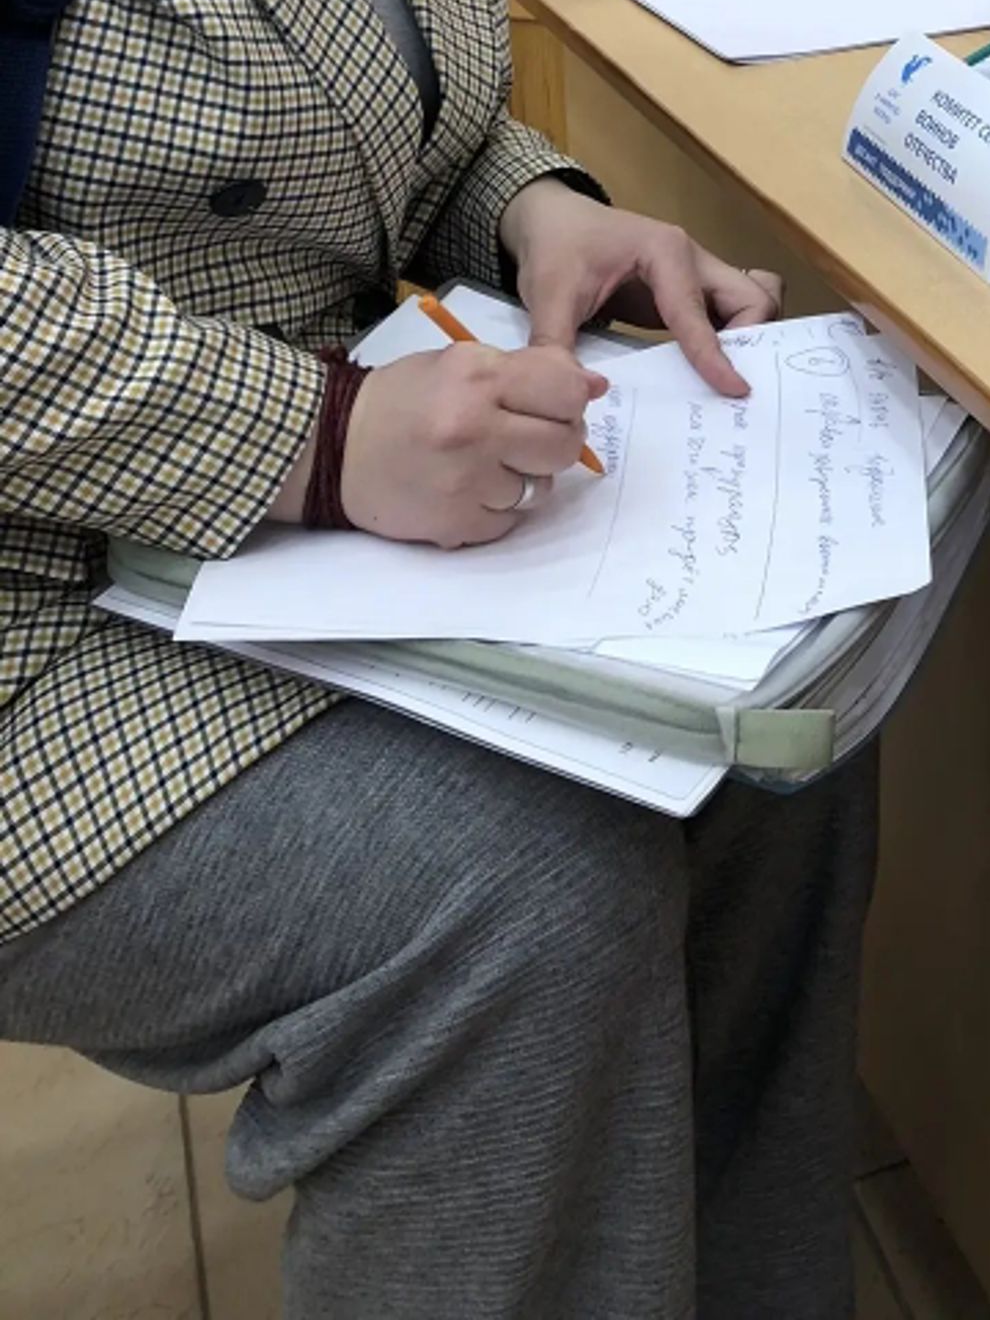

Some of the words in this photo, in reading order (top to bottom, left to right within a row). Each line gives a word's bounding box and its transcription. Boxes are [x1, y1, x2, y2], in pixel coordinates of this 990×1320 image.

[914, 109, 960, 150] ВОИНОВ
[930, 90, 982, 131] КОМИТЕТ
[903, 132, 958, 185] ОТЕЧЕСТВА
